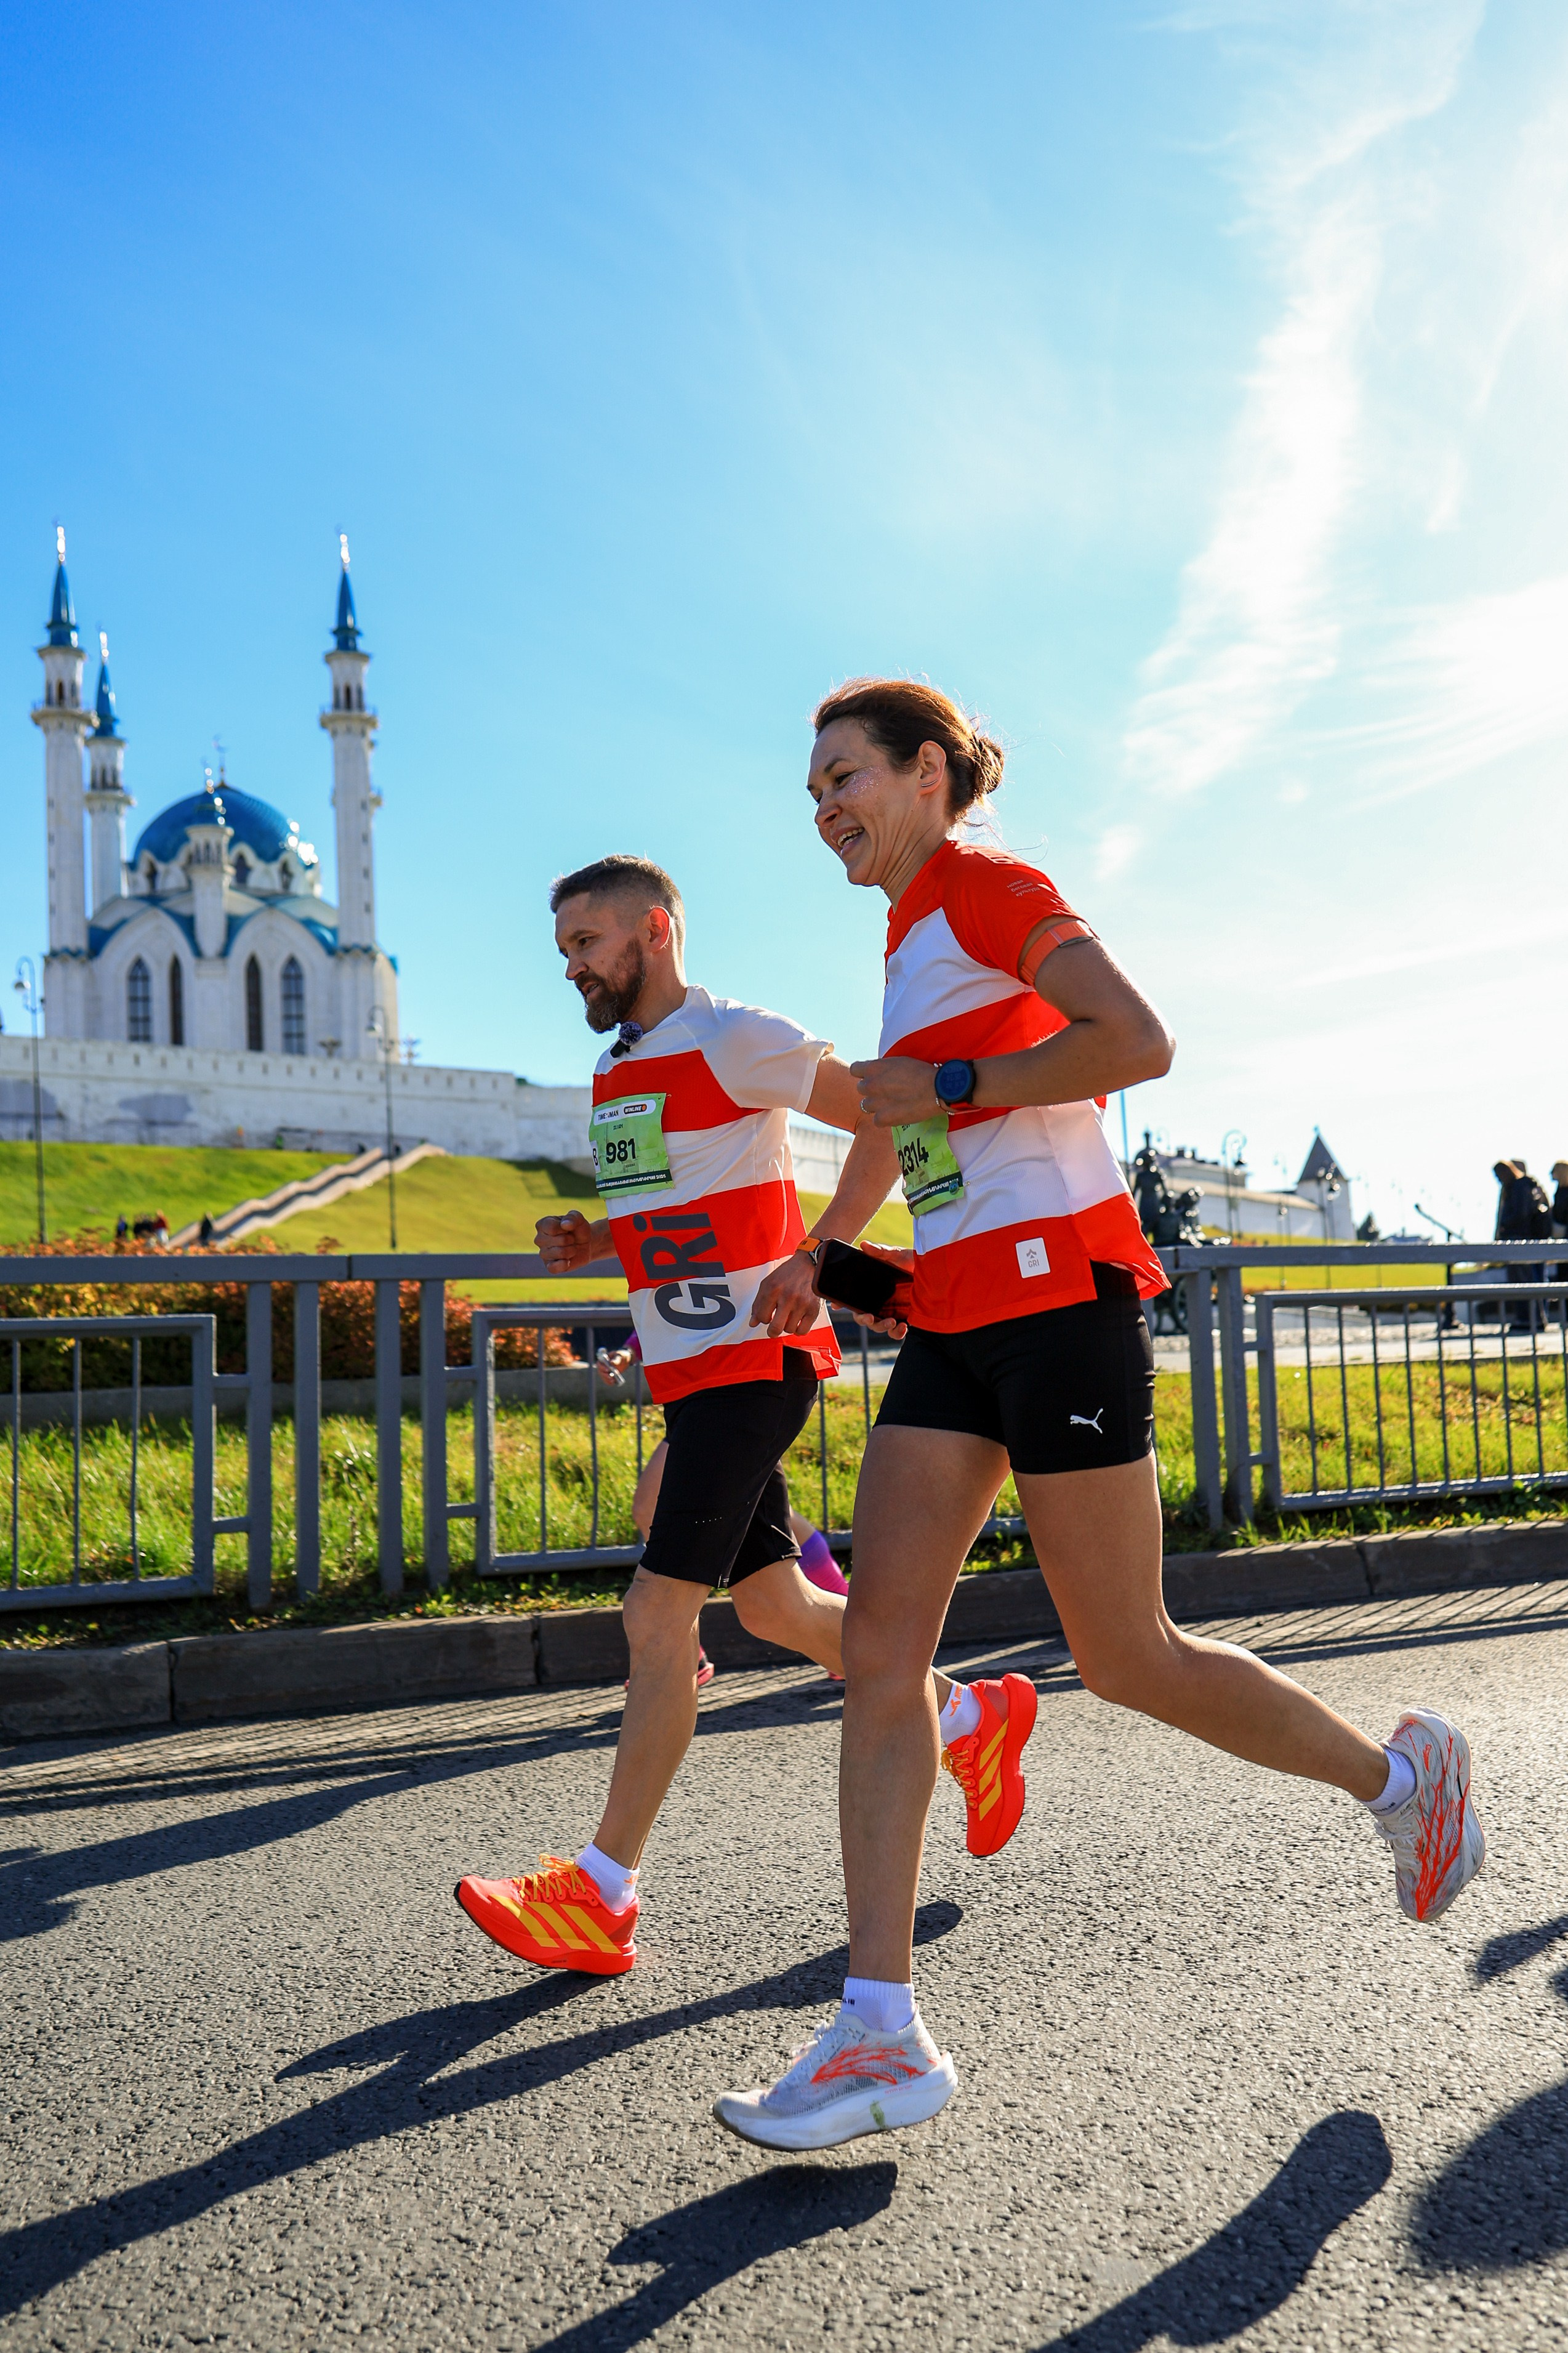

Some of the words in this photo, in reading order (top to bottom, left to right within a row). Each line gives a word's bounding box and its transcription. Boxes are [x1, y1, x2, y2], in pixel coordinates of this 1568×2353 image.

[1007, 879, 1024, 888] новая
[1011, 882, 1033, 892] беговая
[1015, 887, 1040, 897] культура
[606, 1138, 636, 1164] 981
[898, 1137, 929, 1176] 2314
[1027, 1259, 1040, 1268] GRI
